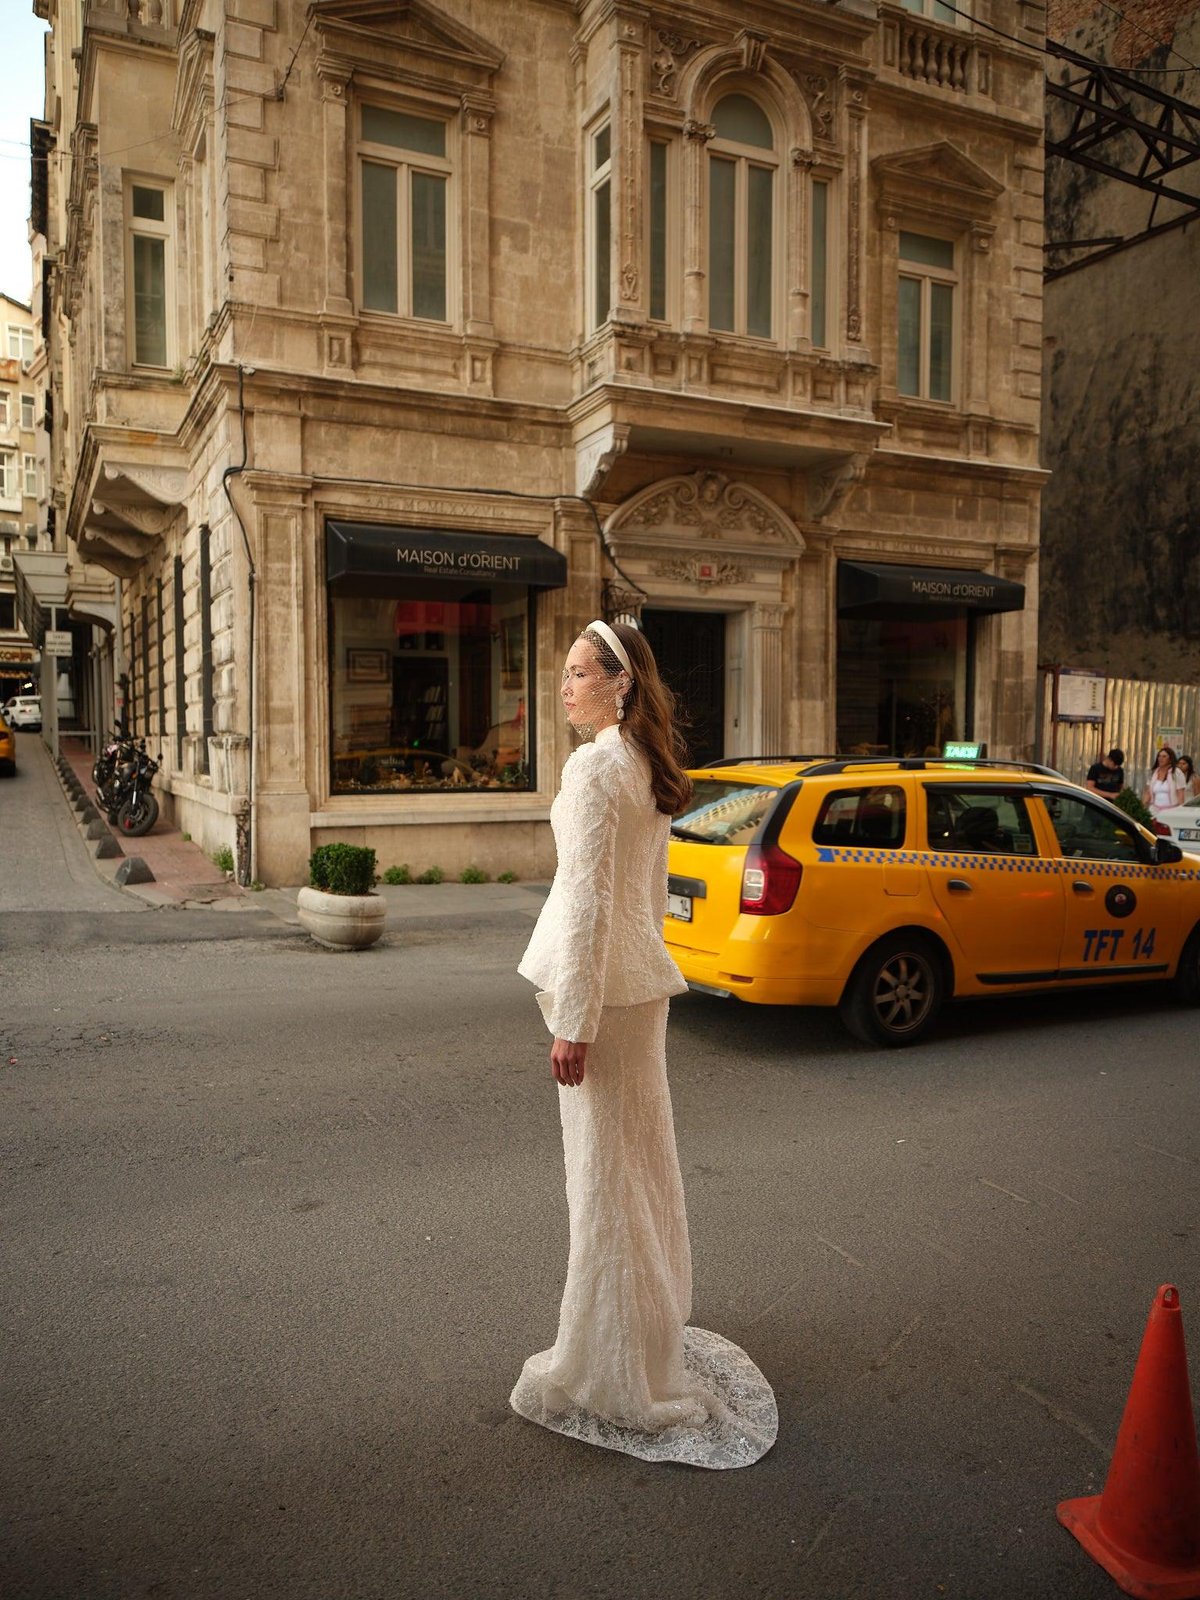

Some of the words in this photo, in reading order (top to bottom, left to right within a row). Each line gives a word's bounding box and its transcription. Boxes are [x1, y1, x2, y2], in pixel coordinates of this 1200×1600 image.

[396, 548, 454, 567] MAISON
[458, 552, 521, 571] d'ORIENT
[424, 566, 437, 575] Real
[912, 581, 951, 595] MAISON
[952, 583, 995, 598] d'ORIENT
[1083, 929, 1124, 961] TFT
[1132, 927, 1156, 960] 14
